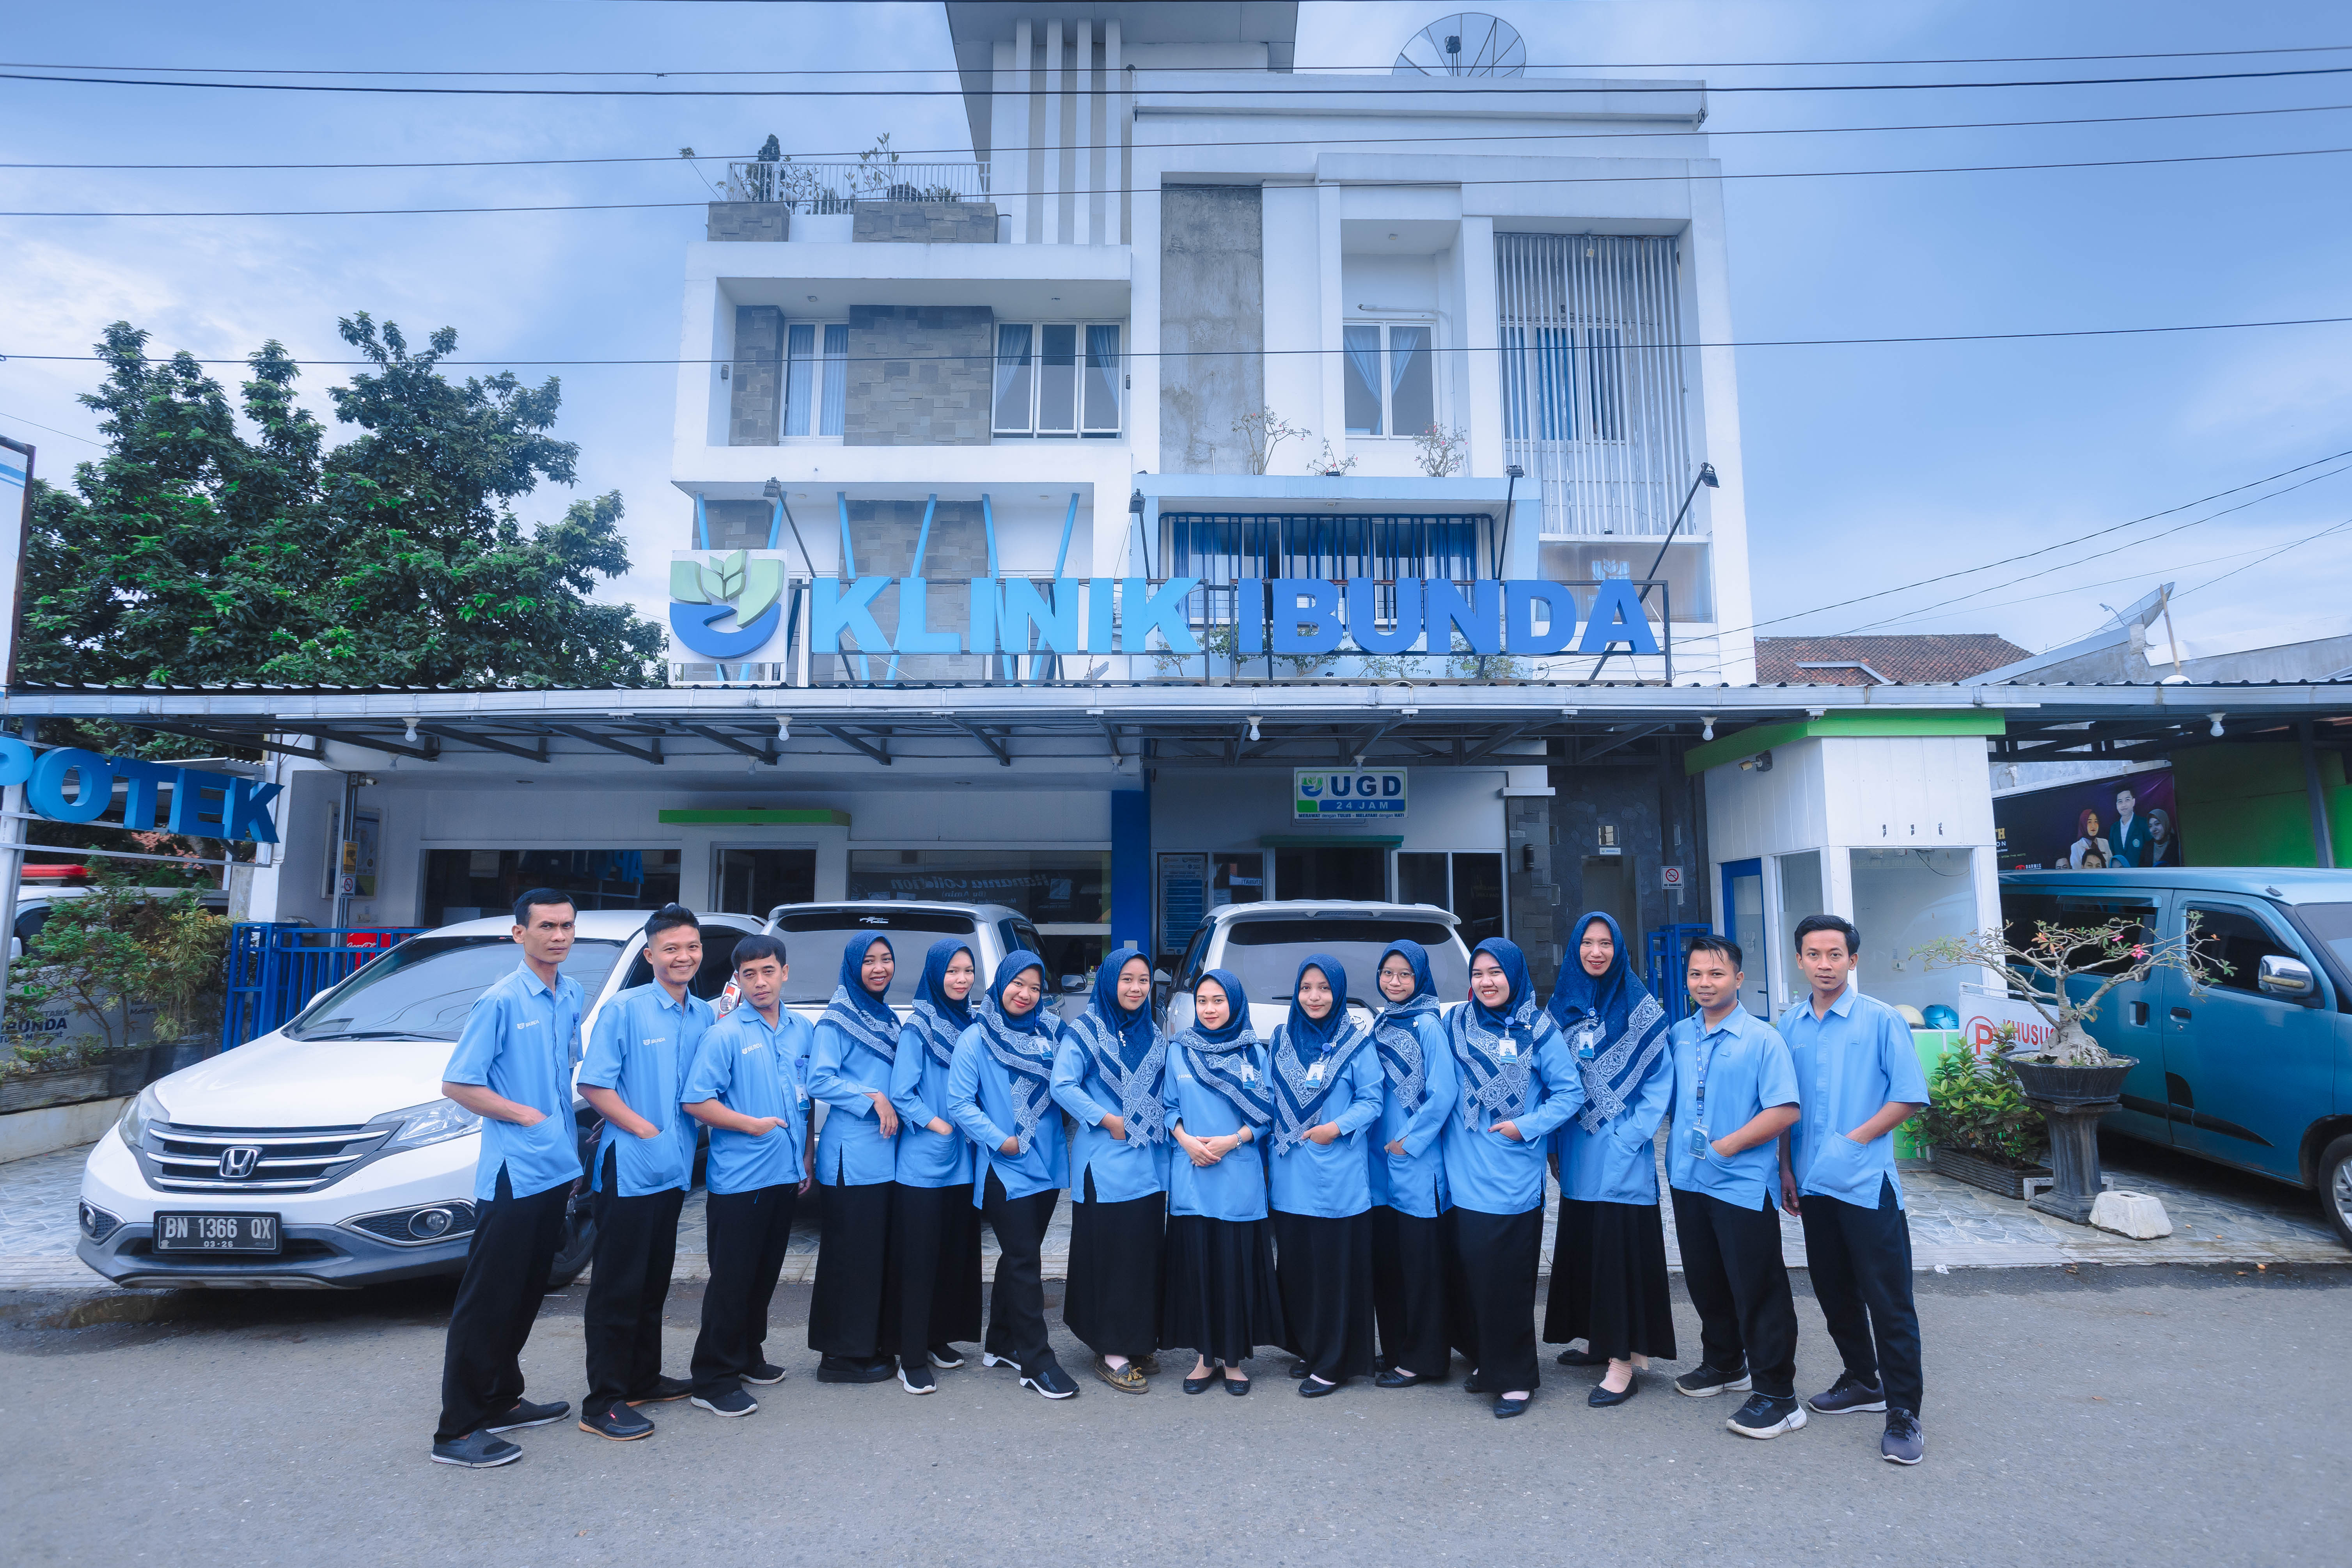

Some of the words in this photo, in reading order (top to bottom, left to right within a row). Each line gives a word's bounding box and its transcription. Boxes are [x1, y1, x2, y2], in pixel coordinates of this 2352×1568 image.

[812, 576, 1201, 655] KLINIK
[1238, 577, 1660, 655] IBUNDA
[1330, 775, 1401, 797] UGD
[525, 1018, 540, 1027] IBUNDA
[2003, 1019, 2055, 1046] KHUSU
[165, 1218, 188, 1238] BN
[198, 1218, 238, 1238] 1366
[251, 1219, 271, 1239] QX
